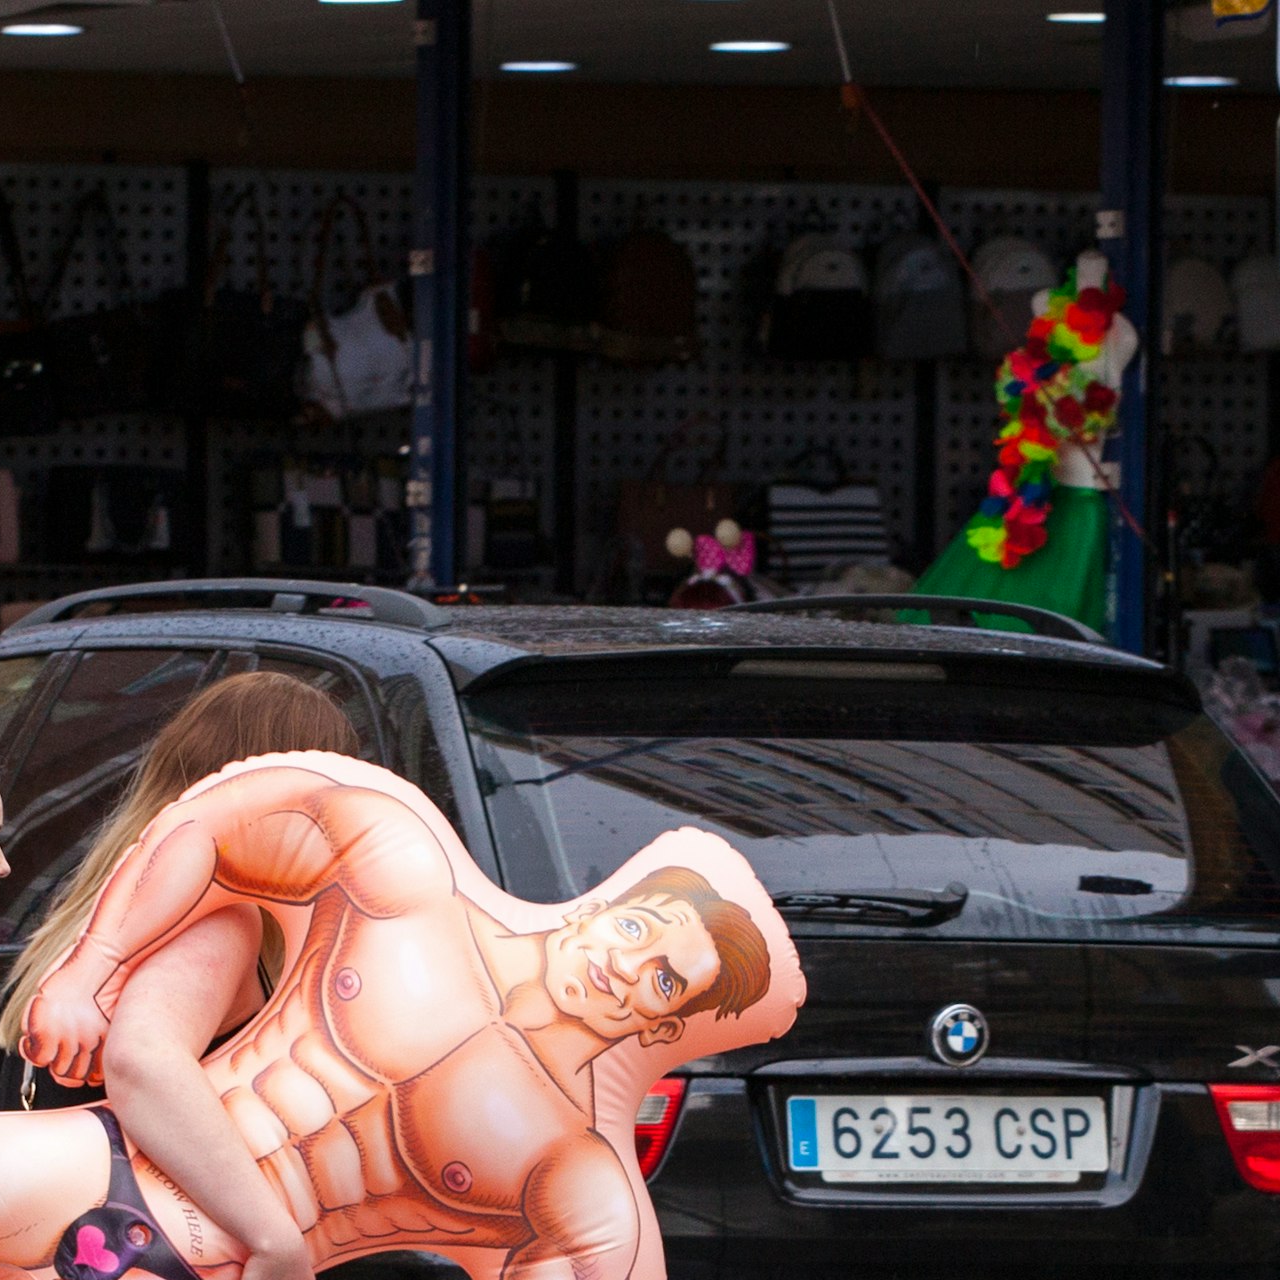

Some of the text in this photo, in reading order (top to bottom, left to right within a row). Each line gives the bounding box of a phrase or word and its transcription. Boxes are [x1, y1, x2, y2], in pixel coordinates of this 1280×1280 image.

[799, 1140, 810, 1156] E
[832, 1106, 1091, 1160] 6253 CSP
[145, 1162, 204, 1258] BLOW HERE
